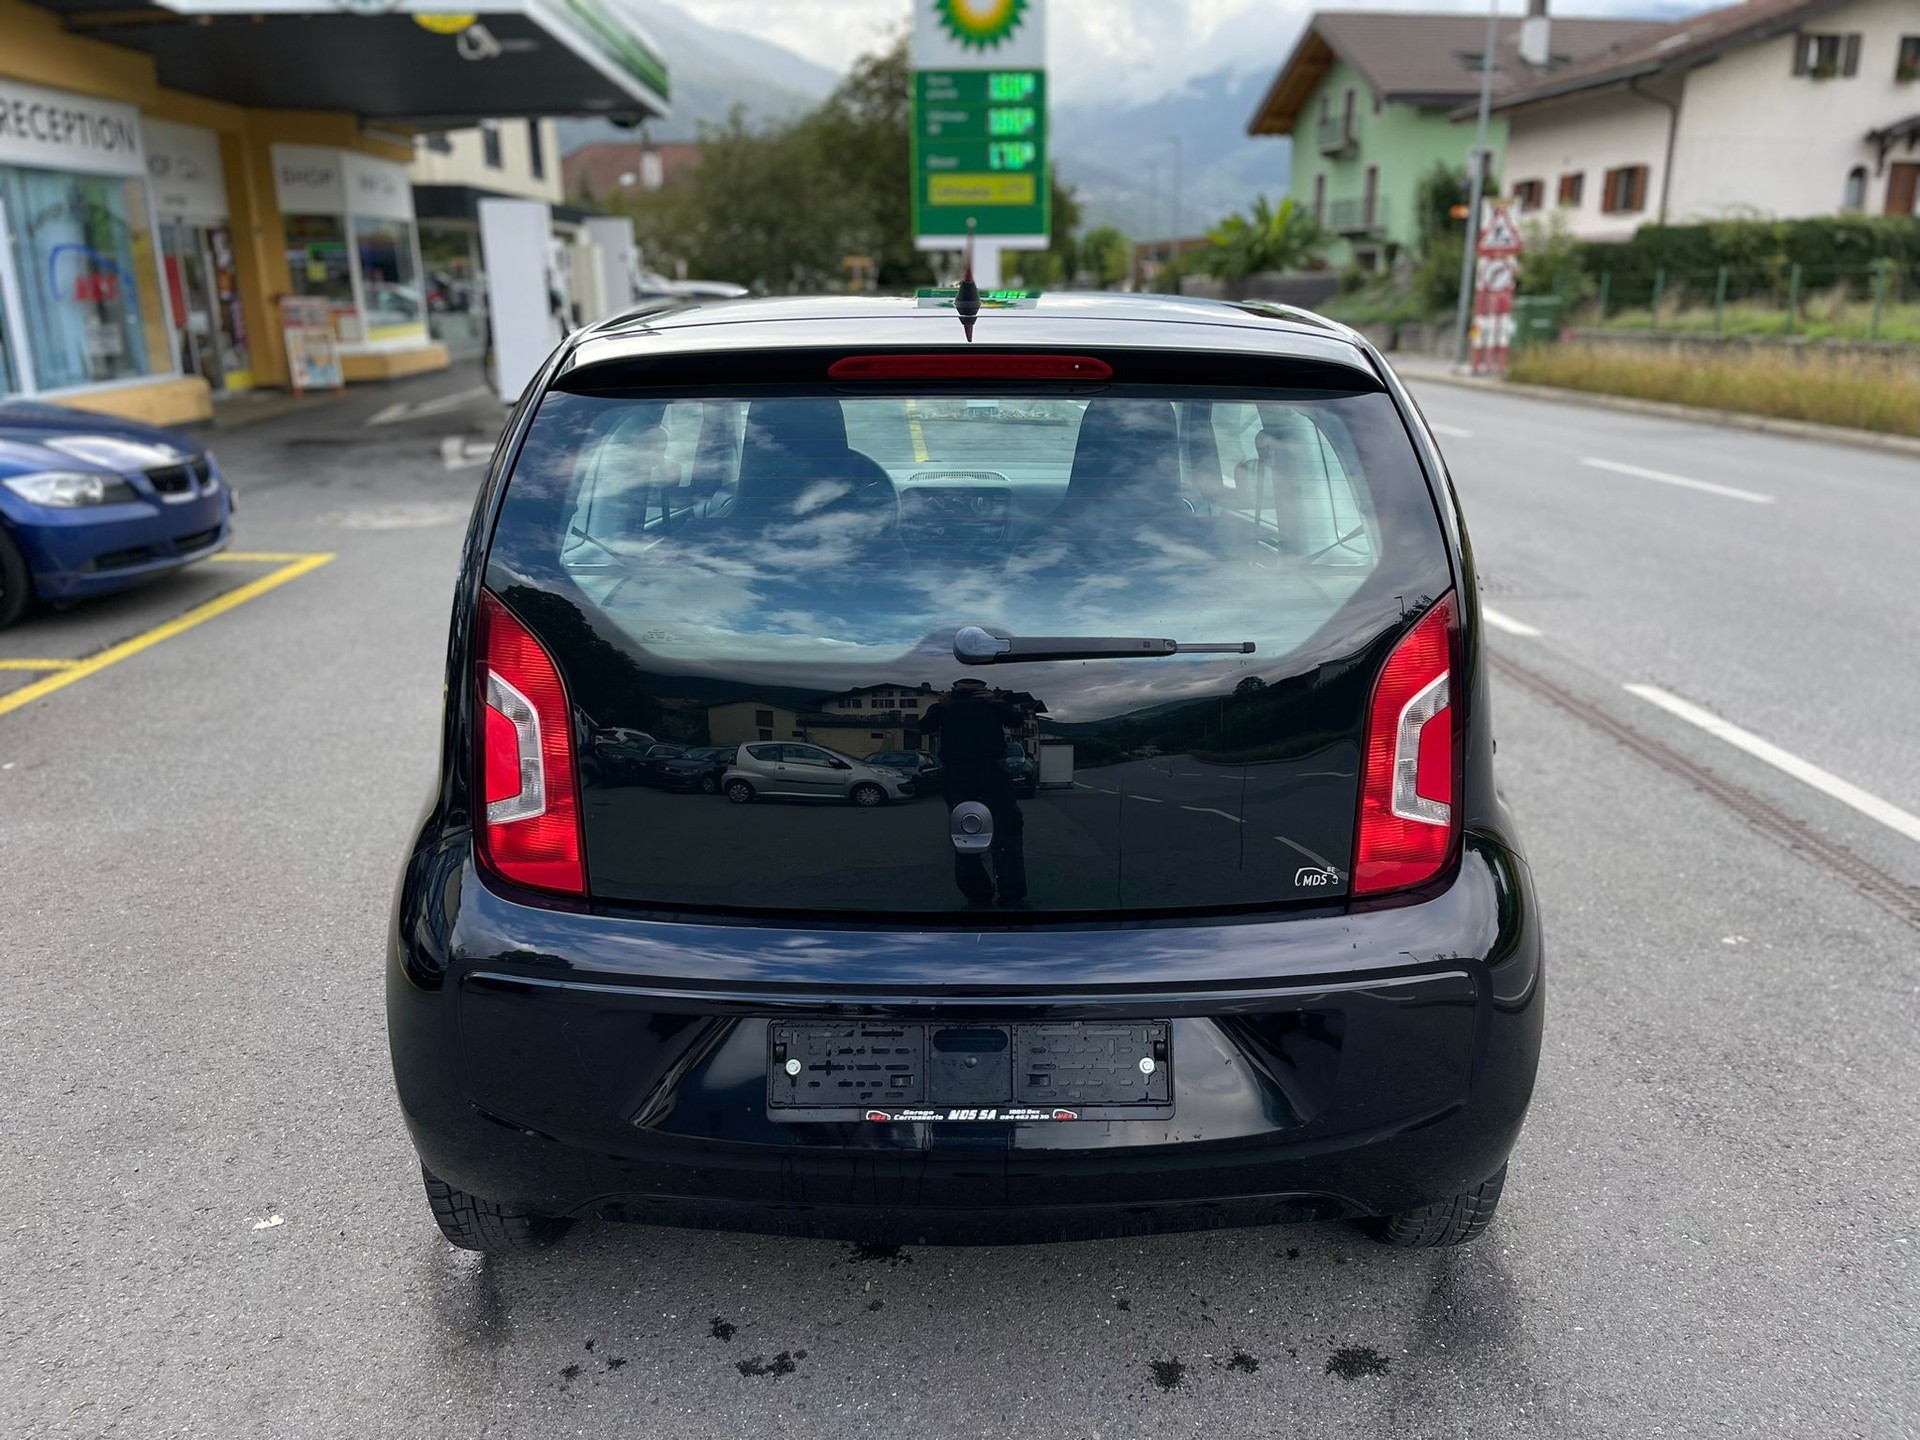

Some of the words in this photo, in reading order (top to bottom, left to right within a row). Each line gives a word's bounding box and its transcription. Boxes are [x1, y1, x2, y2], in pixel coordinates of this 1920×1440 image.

[1302, 874, 1328, 886] MDS
[948, 1109, 977, 1120] MDS
[977, 1109, 997, 1120] SA
